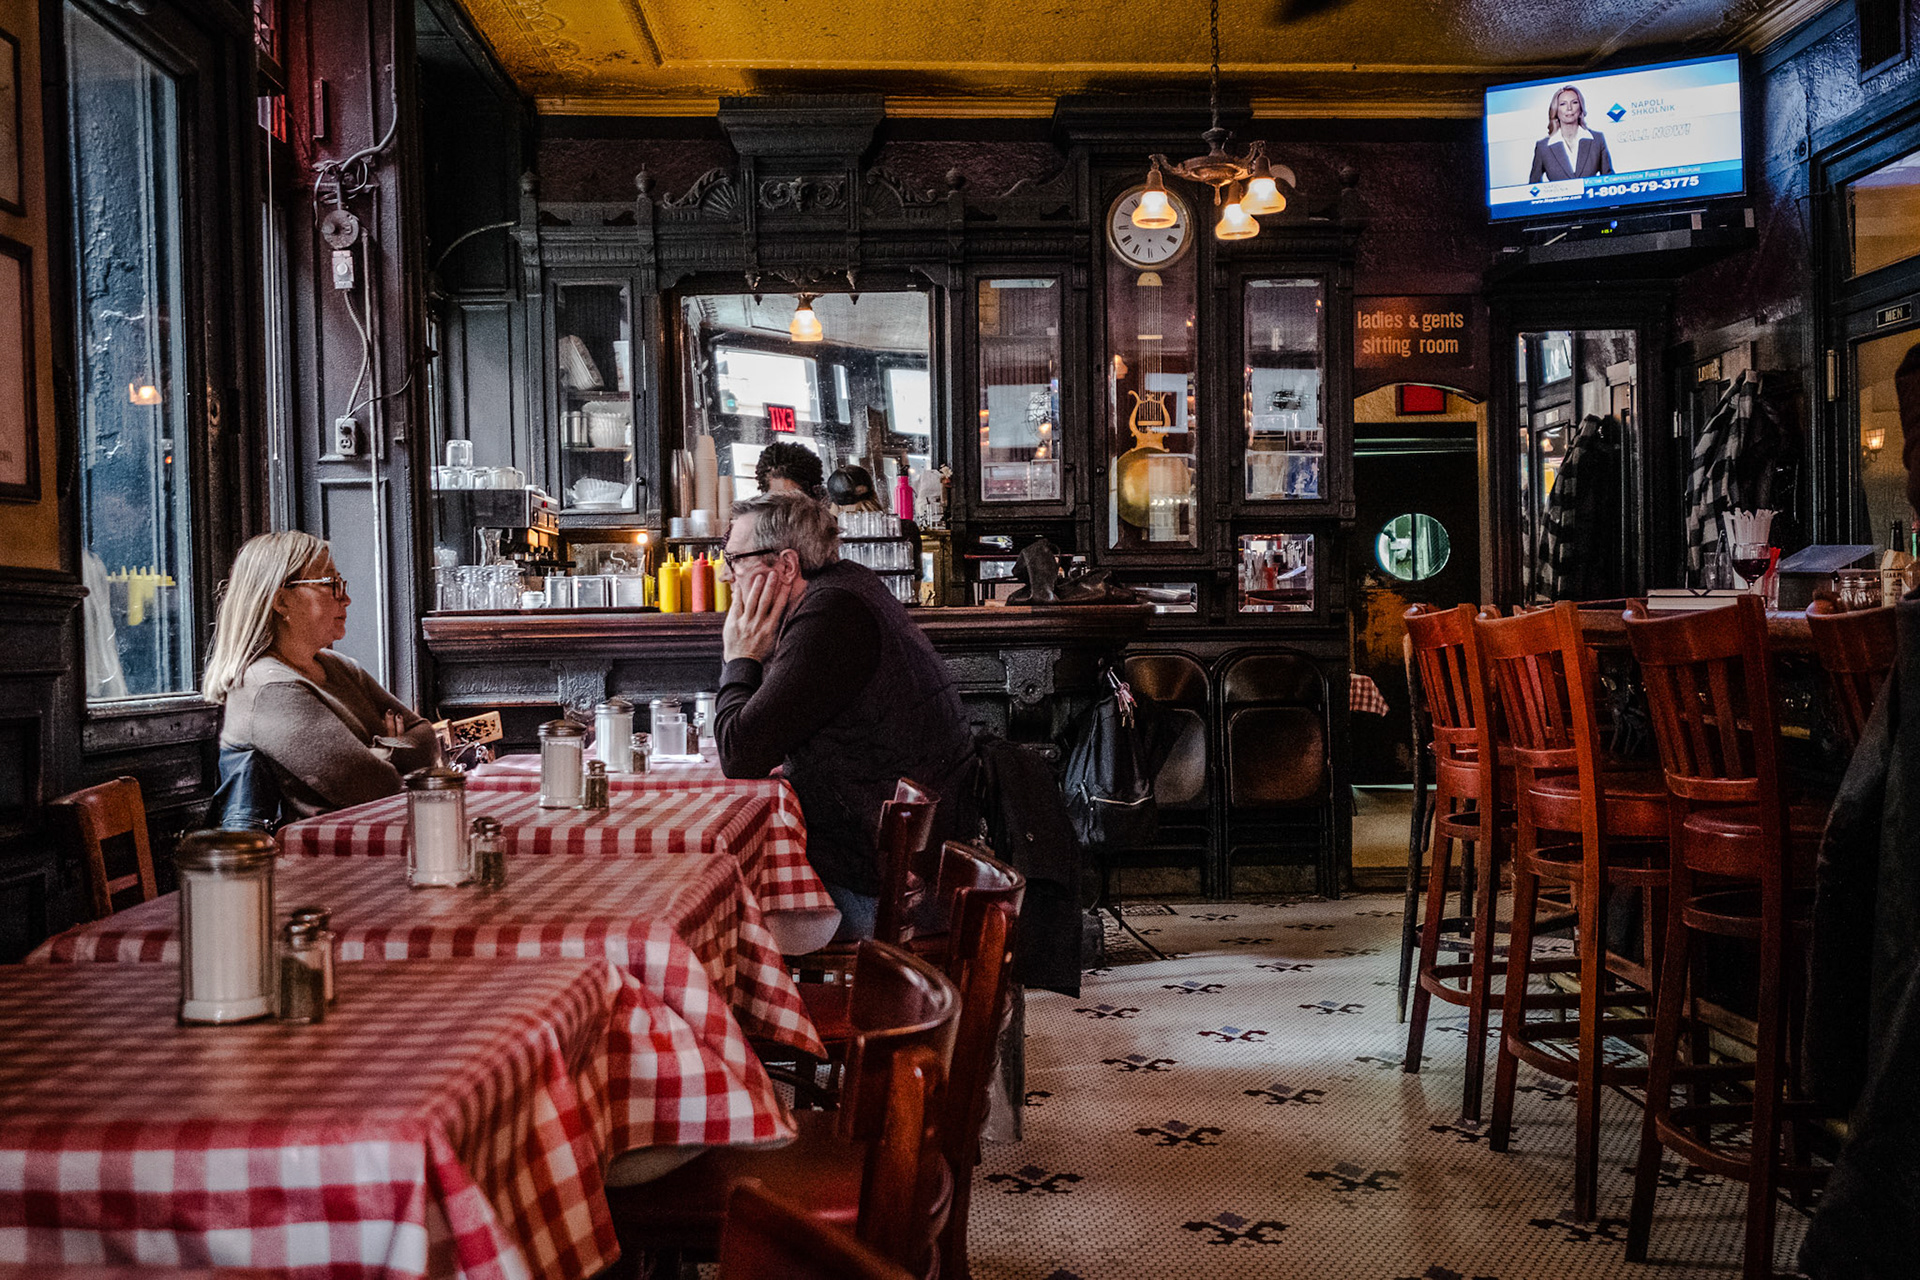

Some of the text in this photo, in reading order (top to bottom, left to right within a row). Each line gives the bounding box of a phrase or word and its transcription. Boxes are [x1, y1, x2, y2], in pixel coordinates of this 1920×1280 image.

[1631, 98, 1664, 109] NAPOLI
[1631, 104, 1675, 116] SHKOLNIK
[1586, 175, 1699, 198] 1-800-679-3775
[1357, 311, 1464, 332] ladies & gents
[1885, 307, 1903, 323] MEN
[1362, 336, 1459, 357] sitting room
